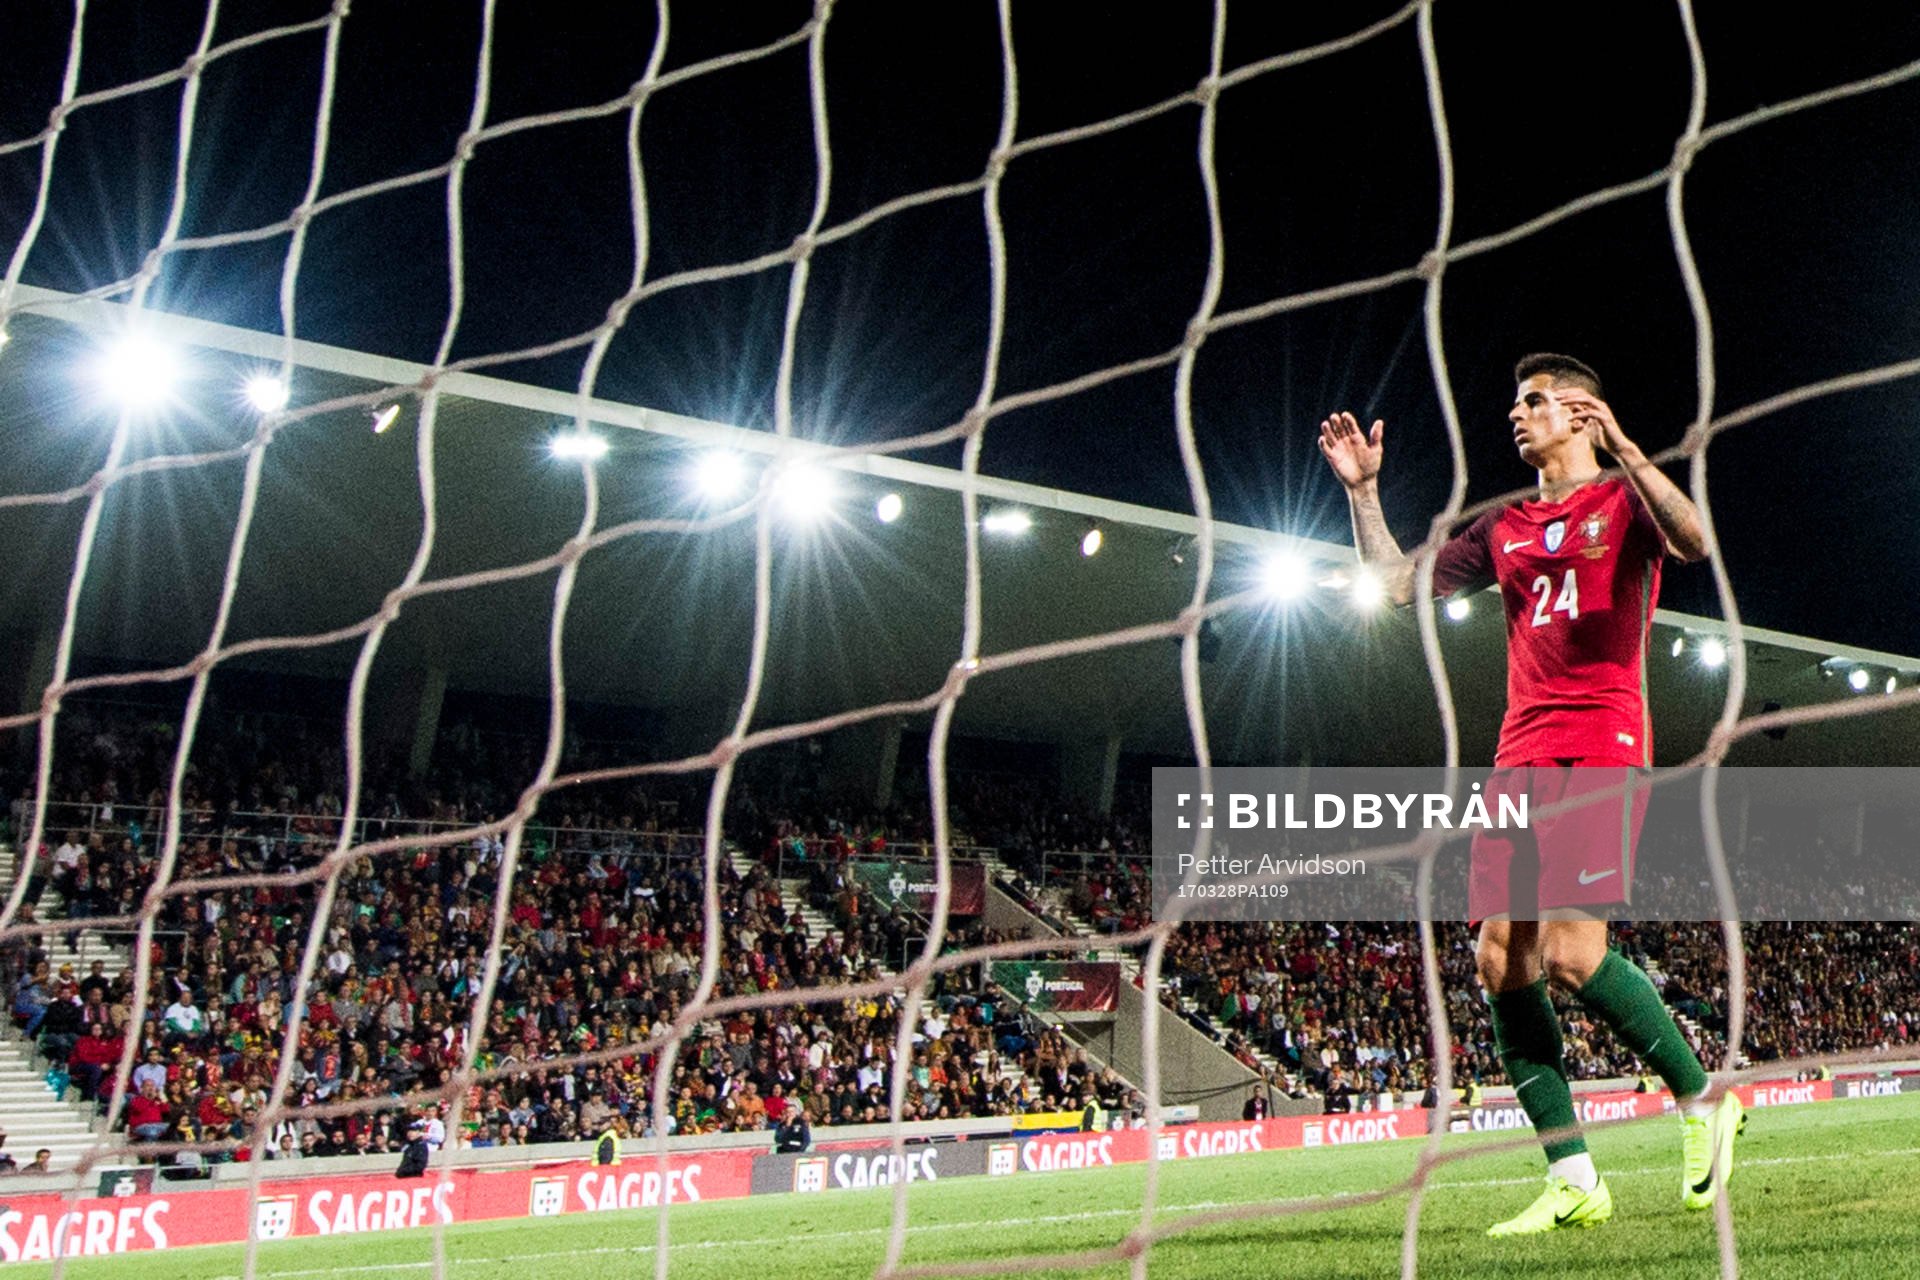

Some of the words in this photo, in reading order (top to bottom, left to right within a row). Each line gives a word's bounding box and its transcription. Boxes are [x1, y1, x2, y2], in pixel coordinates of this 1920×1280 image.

[1532, 569, 1579, 627] 24
[1045, 981, 1084, 991] PORTUGAL
[1184, 1125, 1262, 1156] SAGRES
[1328, 1114, 1398, 1143] SAGRES
[1023, 1136, 1112, 1171] SAGRES
[577, 1164, 702, 1212] SAGRES
[308, 1183, 455, 1235] SAGRES
[0, 1200, 170, 1261] SAGRES
